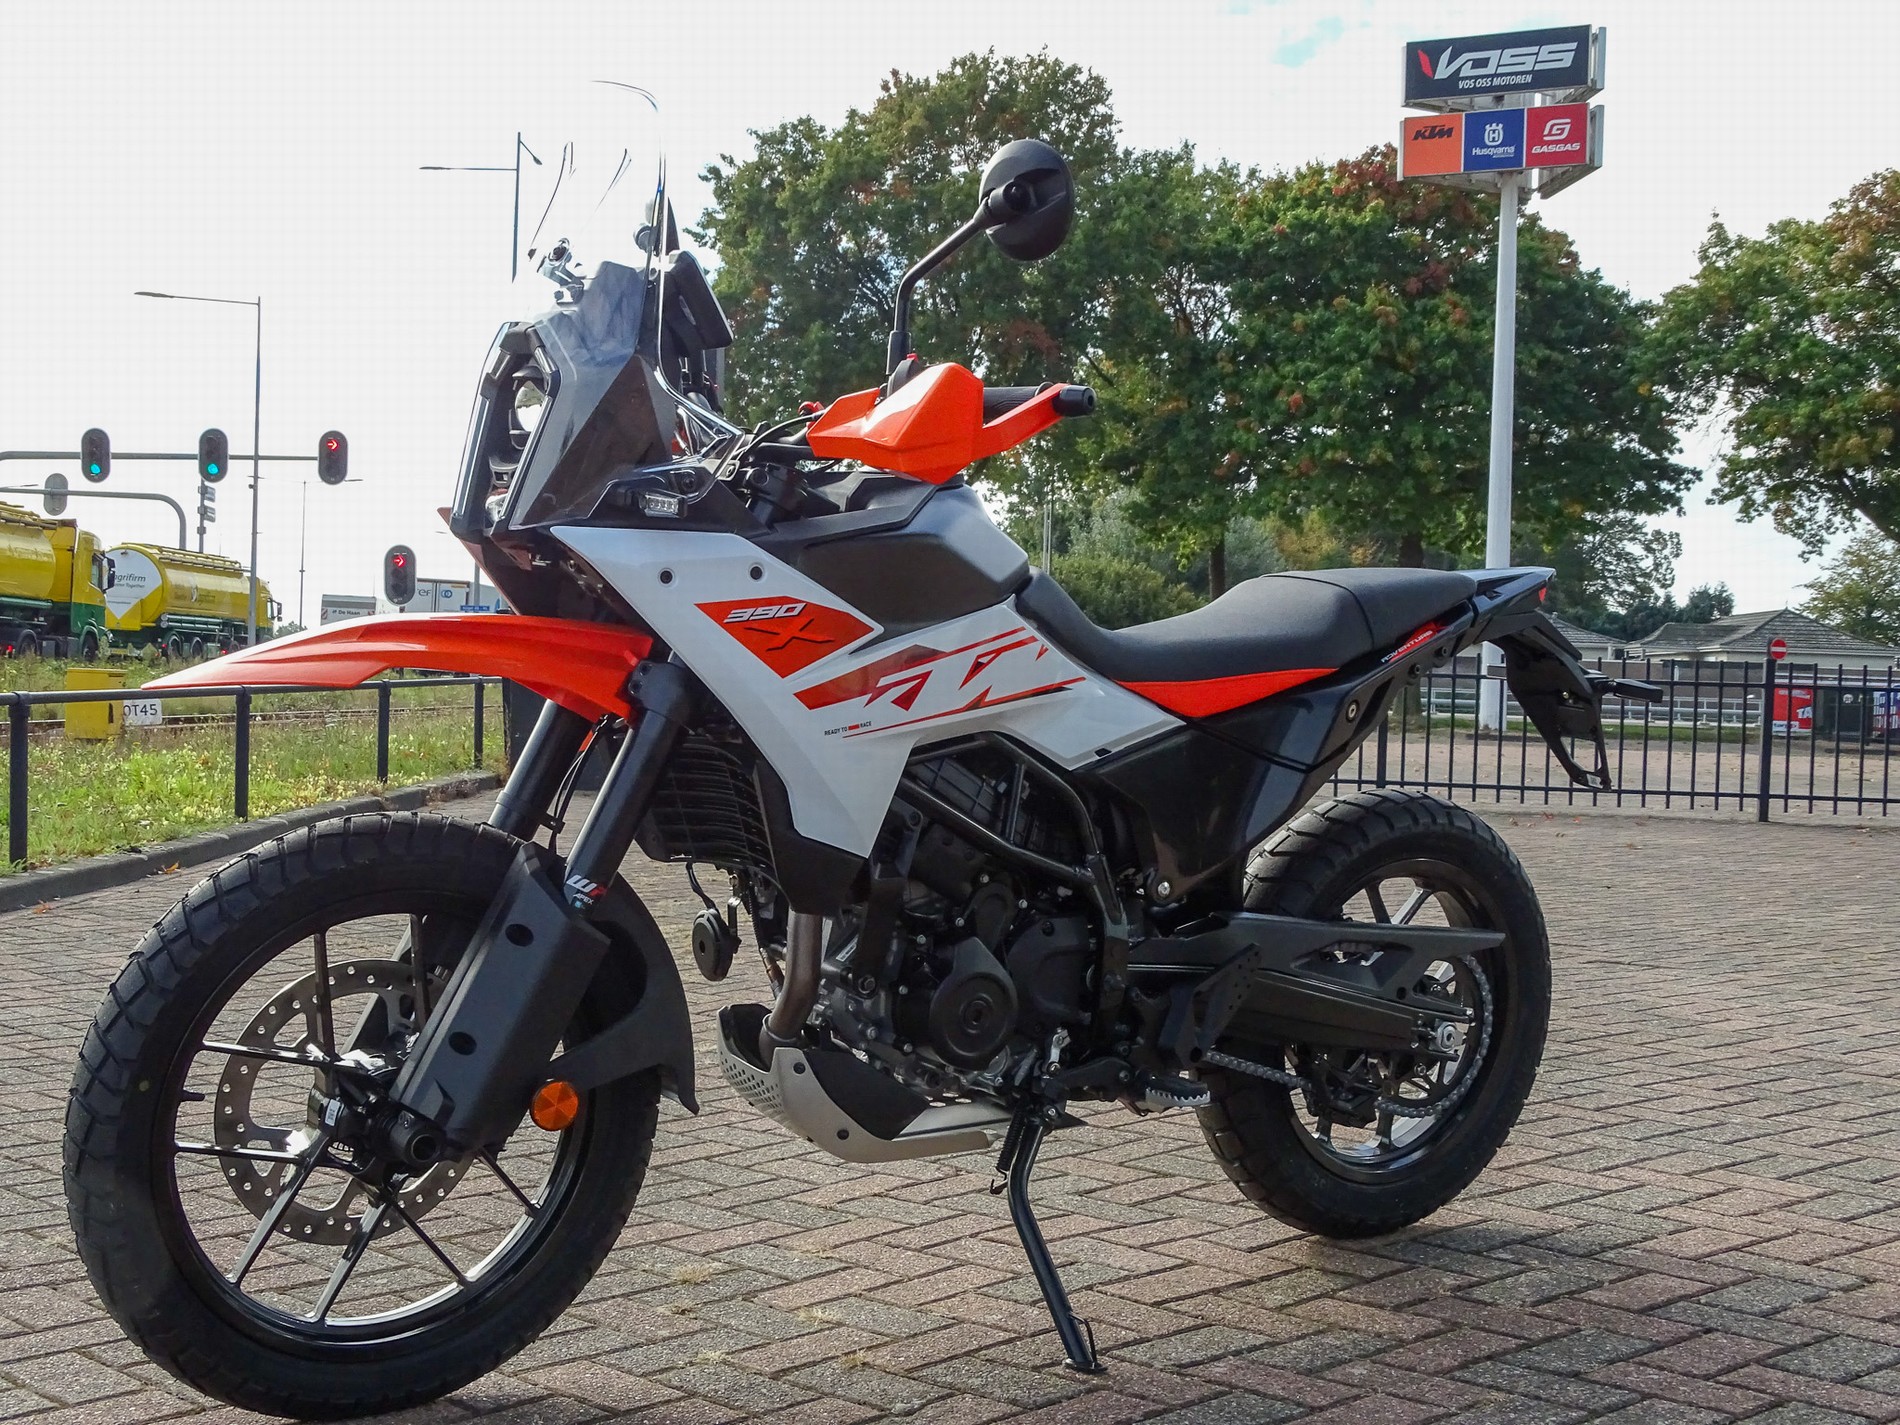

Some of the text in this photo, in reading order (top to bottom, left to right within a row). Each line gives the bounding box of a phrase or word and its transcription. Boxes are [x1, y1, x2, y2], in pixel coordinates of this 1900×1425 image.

[1418, 42, 1578, 79] VOSS
[1458, 74, 1532, 89] VOS OSS MOTOREN
[1412, 125, 1454, 140] KTM
[1472, 145, 1515, 155] Husqvarna
[1531, 142, 1581, 154] GASGAS
[723, 602, 807, 624] 390
[1381, 630, 1433, 663] ADVENTURE
[824, 728, 841, 736] READY
[573, 893, 594, 905] APEX
